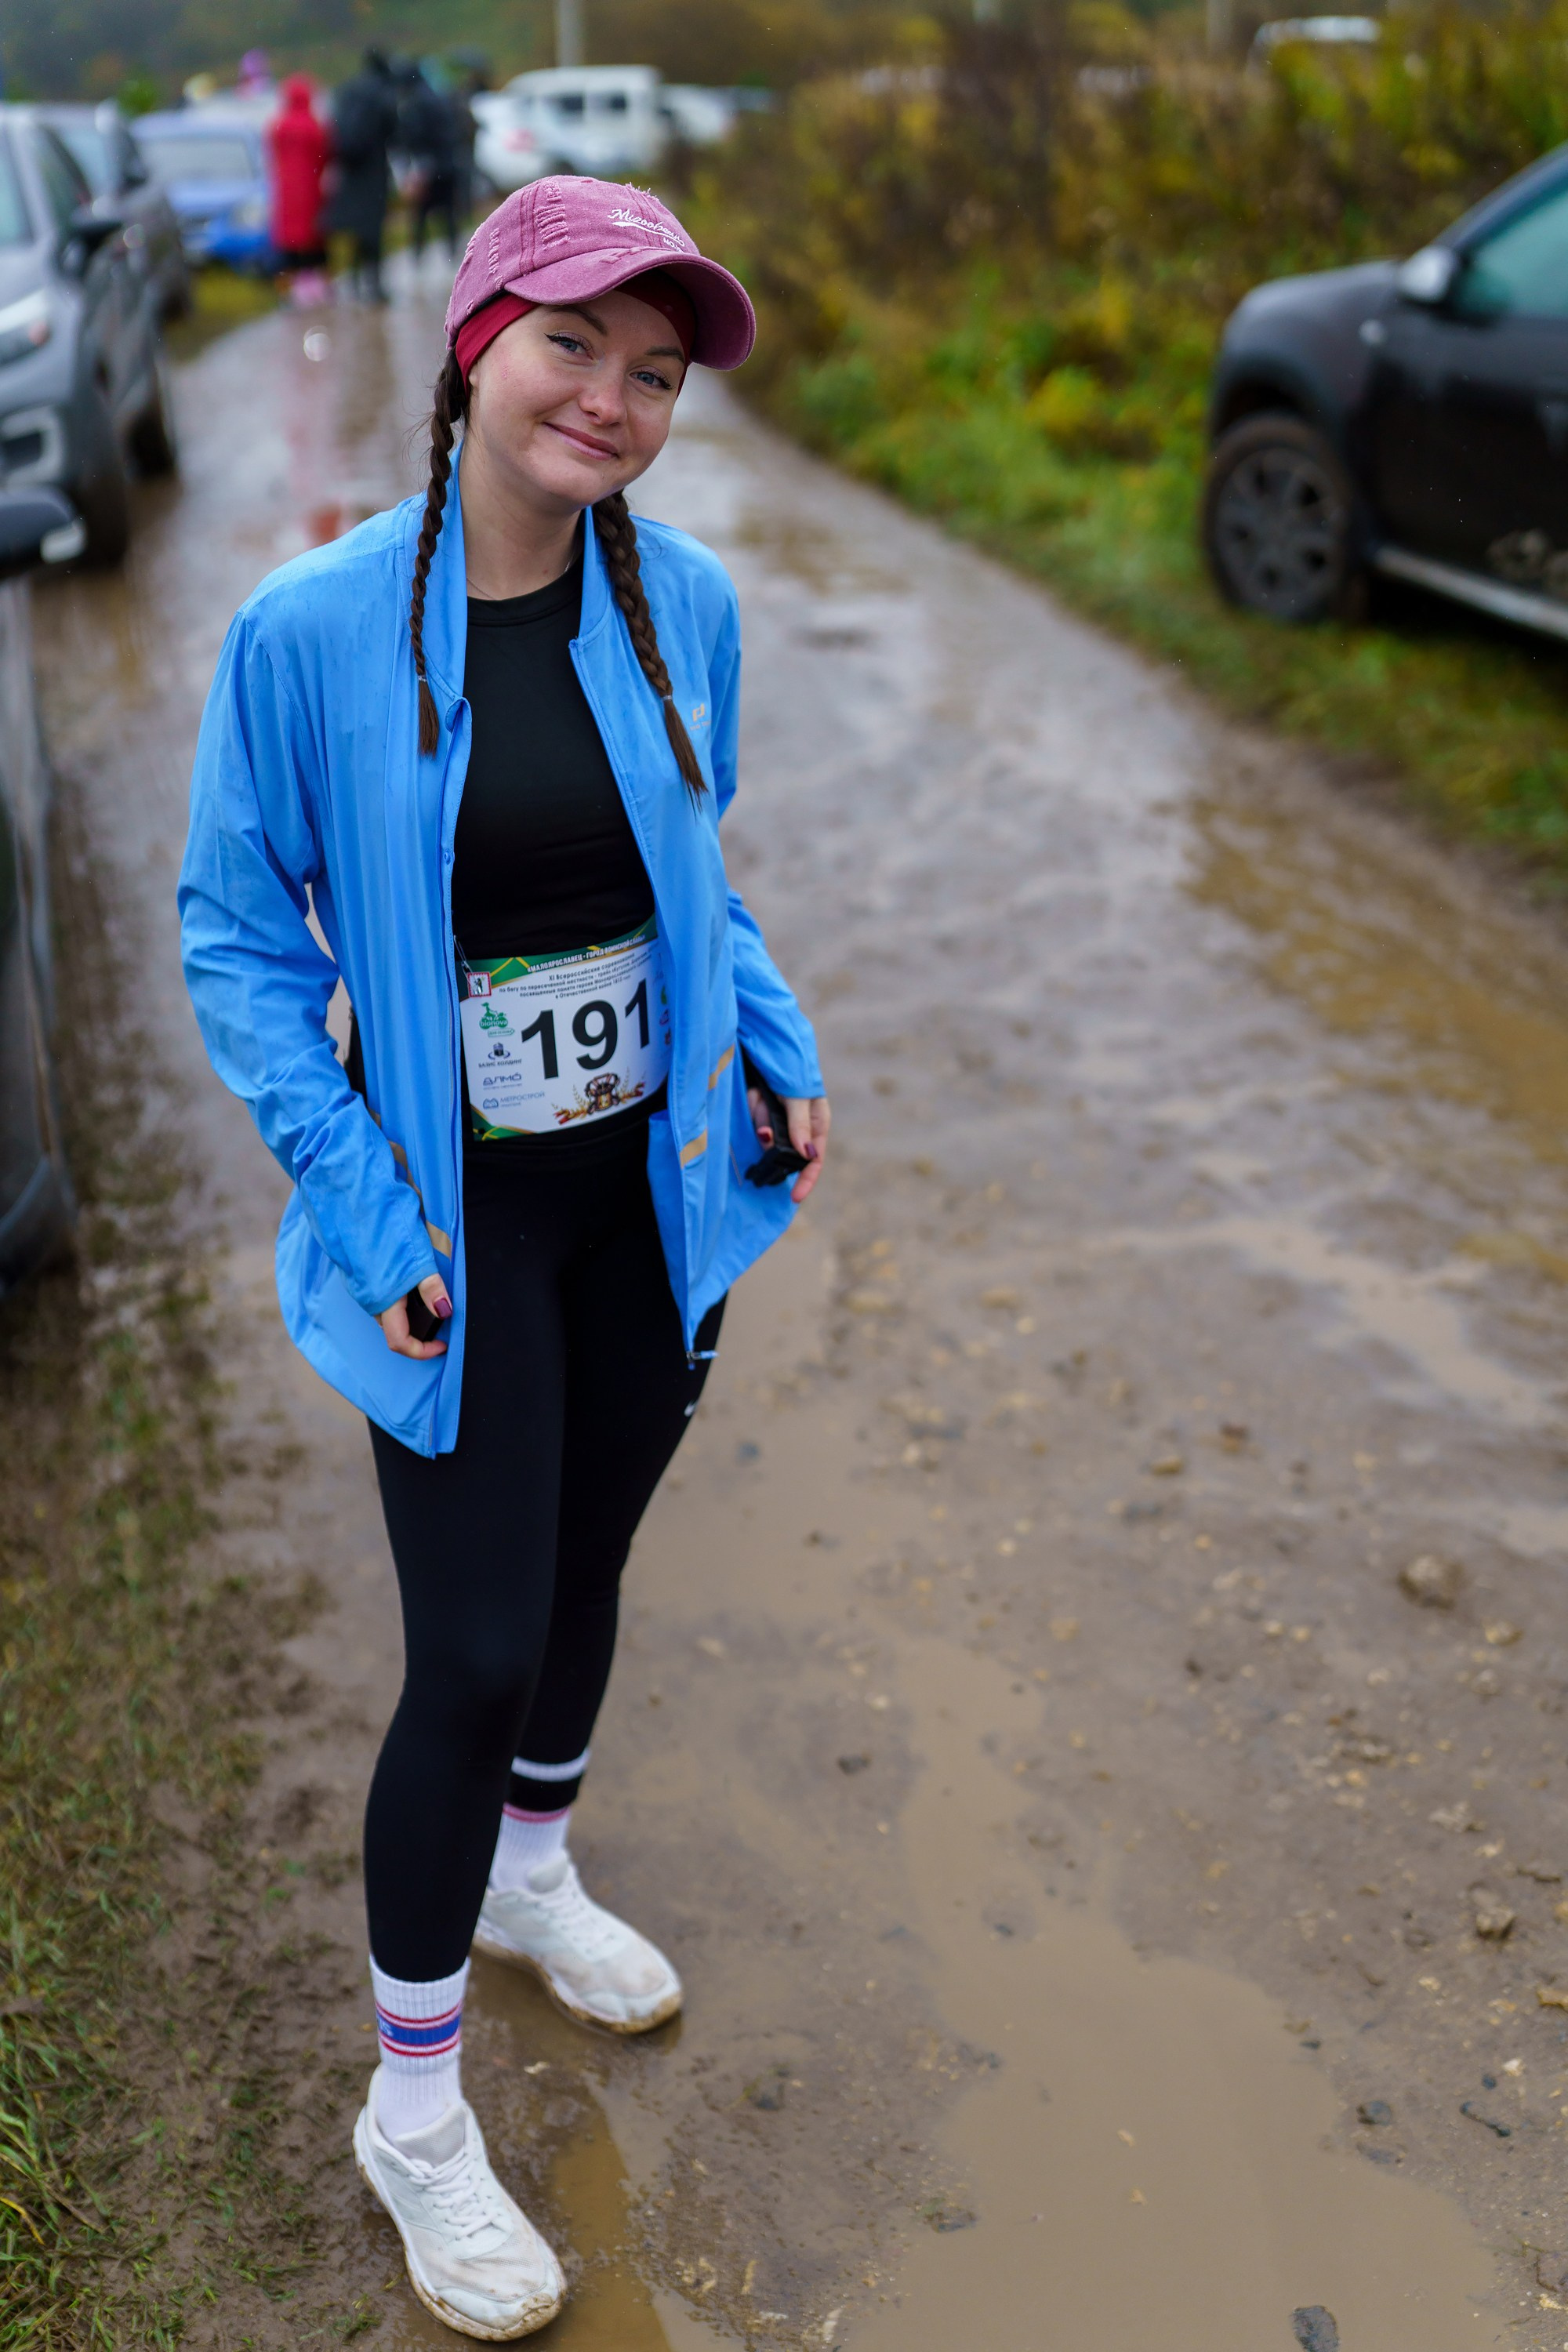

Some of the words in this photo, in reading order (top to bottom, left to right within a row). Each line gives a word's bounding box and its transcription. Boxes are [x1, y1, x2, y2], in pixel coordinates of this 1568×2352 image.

[586, 948, 604, 959] ГОРОД
[556, 966, 601, 980] Всероссийские
[567, 975, 593, 985] местности
[480, 1018, 508, 1027] bionova
[521, 978, 650, 1080] 191
[500, 1091, 545, 1103] МЕТРОСТРОЙ
